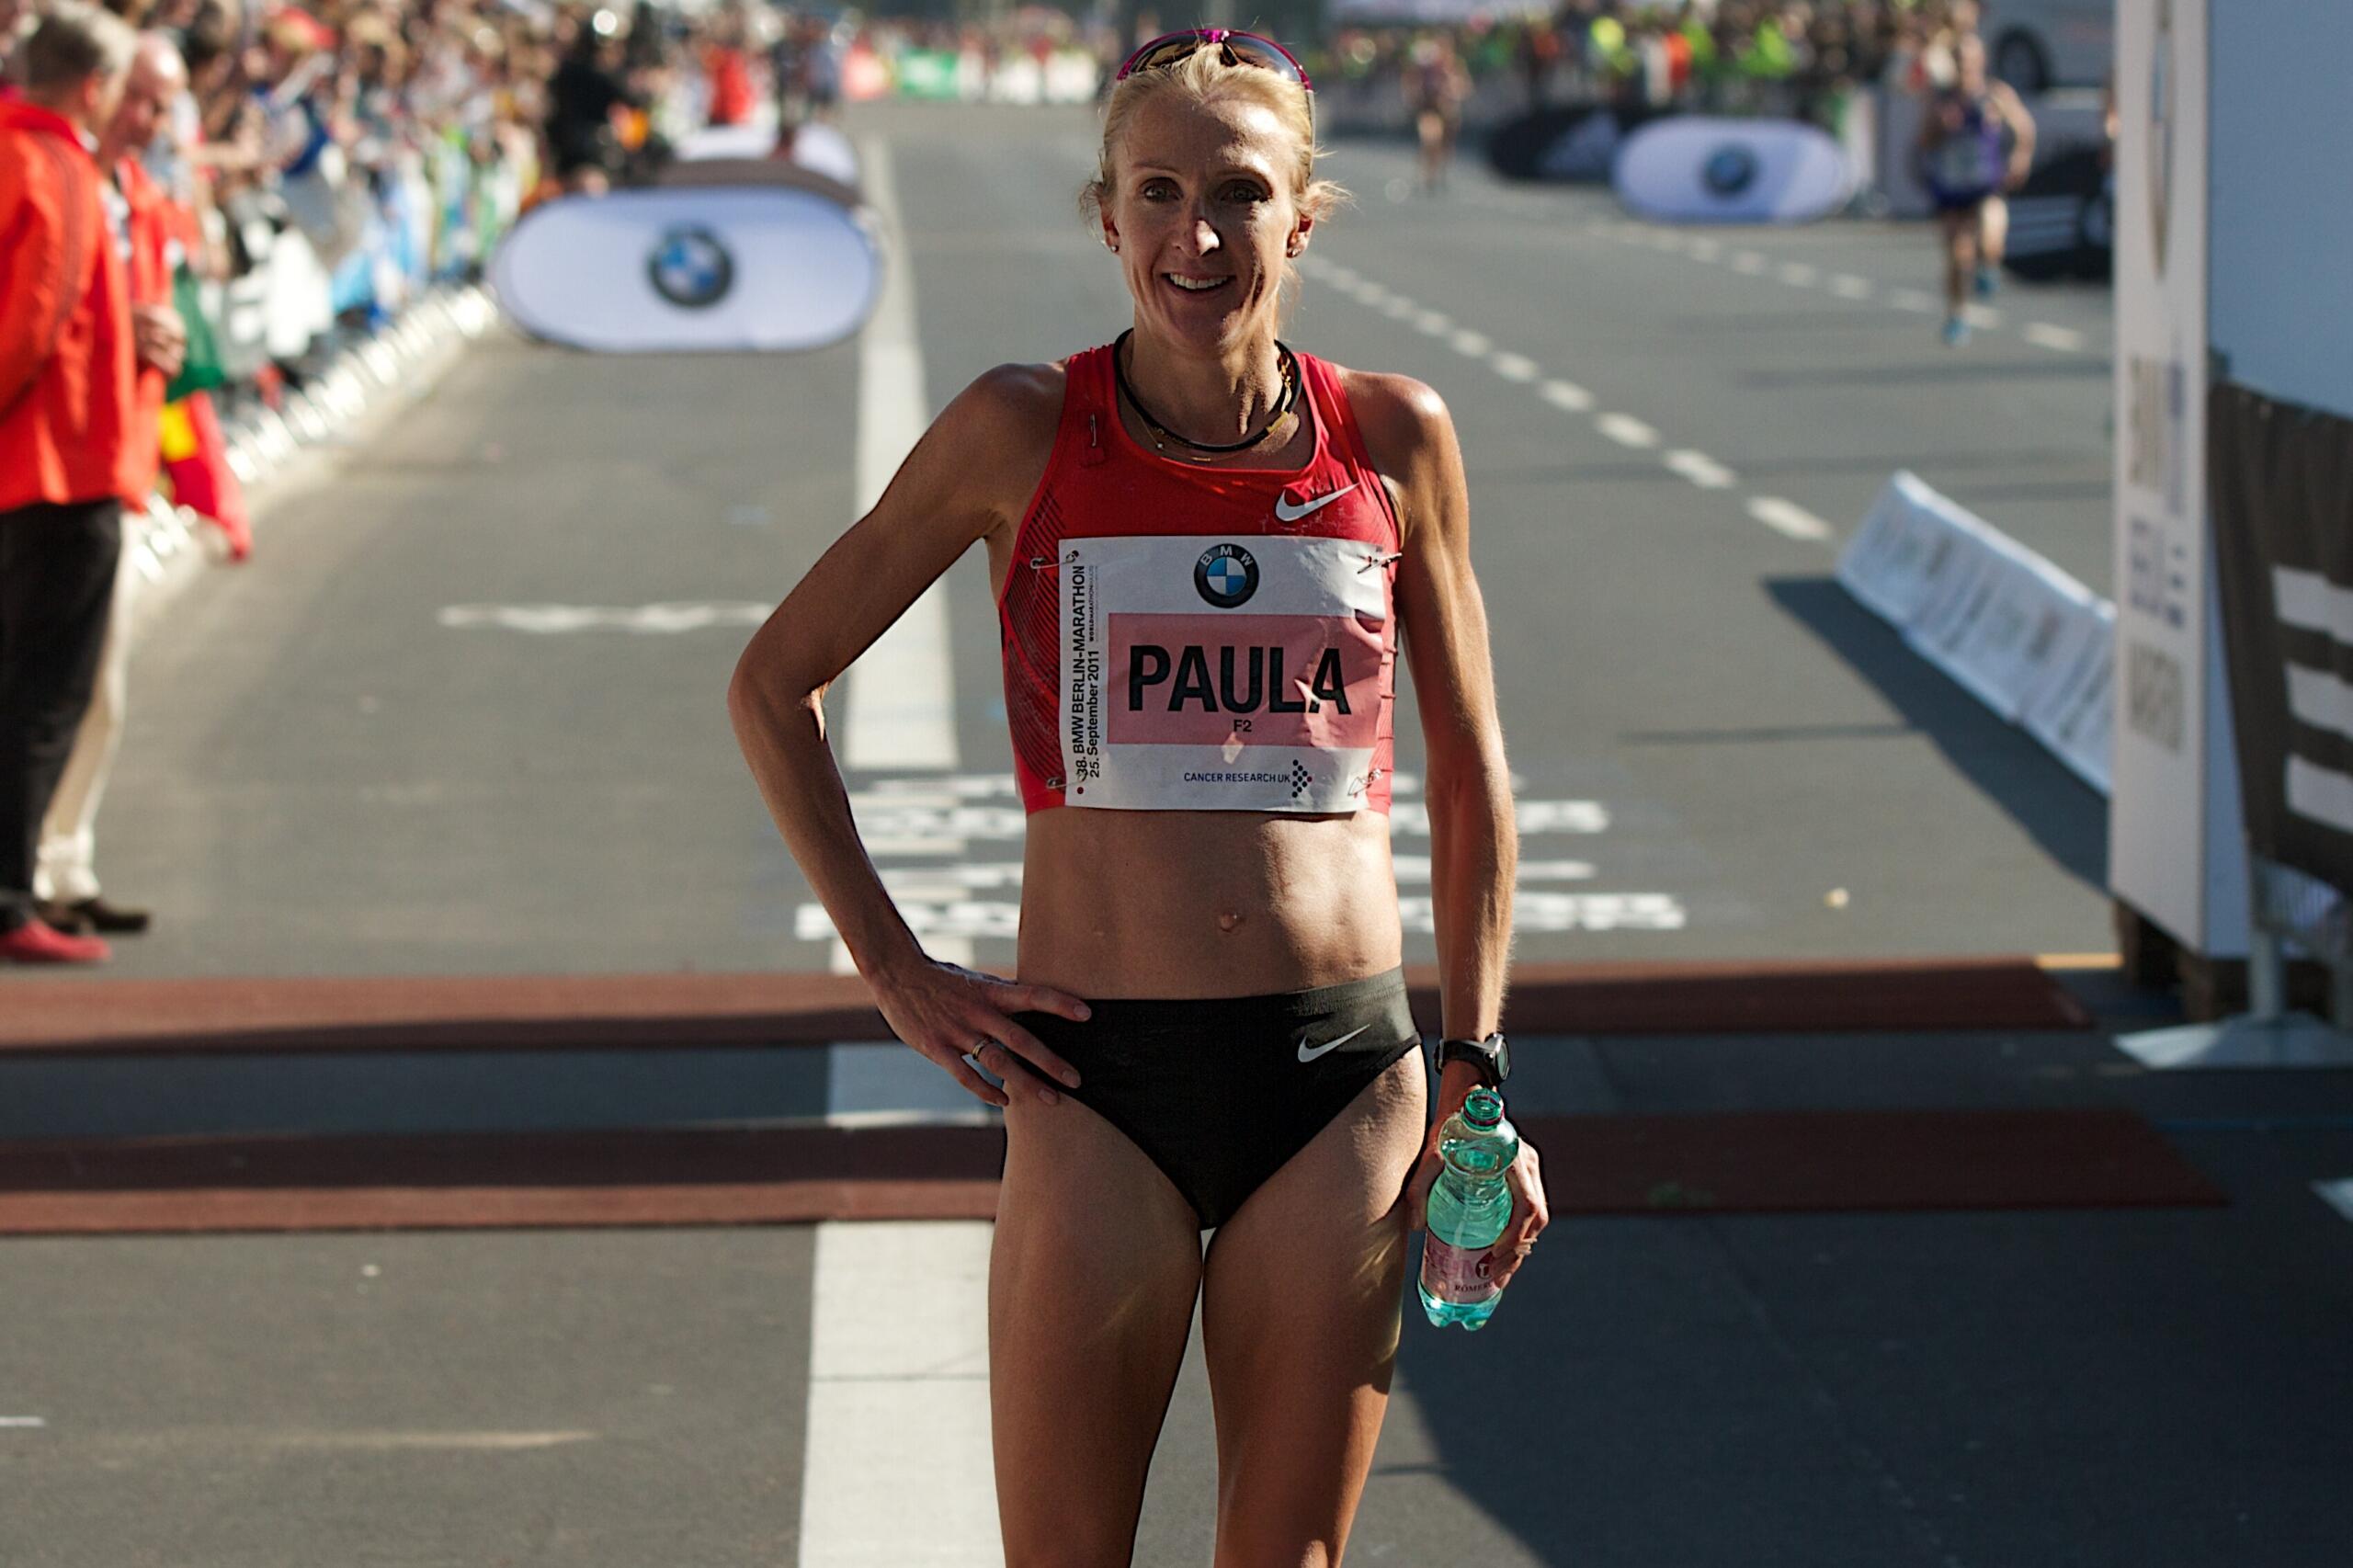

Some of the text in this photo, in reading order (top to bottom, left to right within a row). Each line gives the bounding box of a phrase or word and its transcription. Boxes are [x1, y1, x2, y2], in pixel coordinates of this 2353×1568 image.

[1200, 545, 1254, 566] BMW
[1072, 565, 1088, 779] 38. BMW BERLIN-MARATHON
[1129, 644, 1351, 714] PAULA
[1086, 650, 1100, 778] 25. September 2011
[1233, 719, 1252, 733] F2
[1184, 772, 1290, 783] CANCER RESEARCH UK
